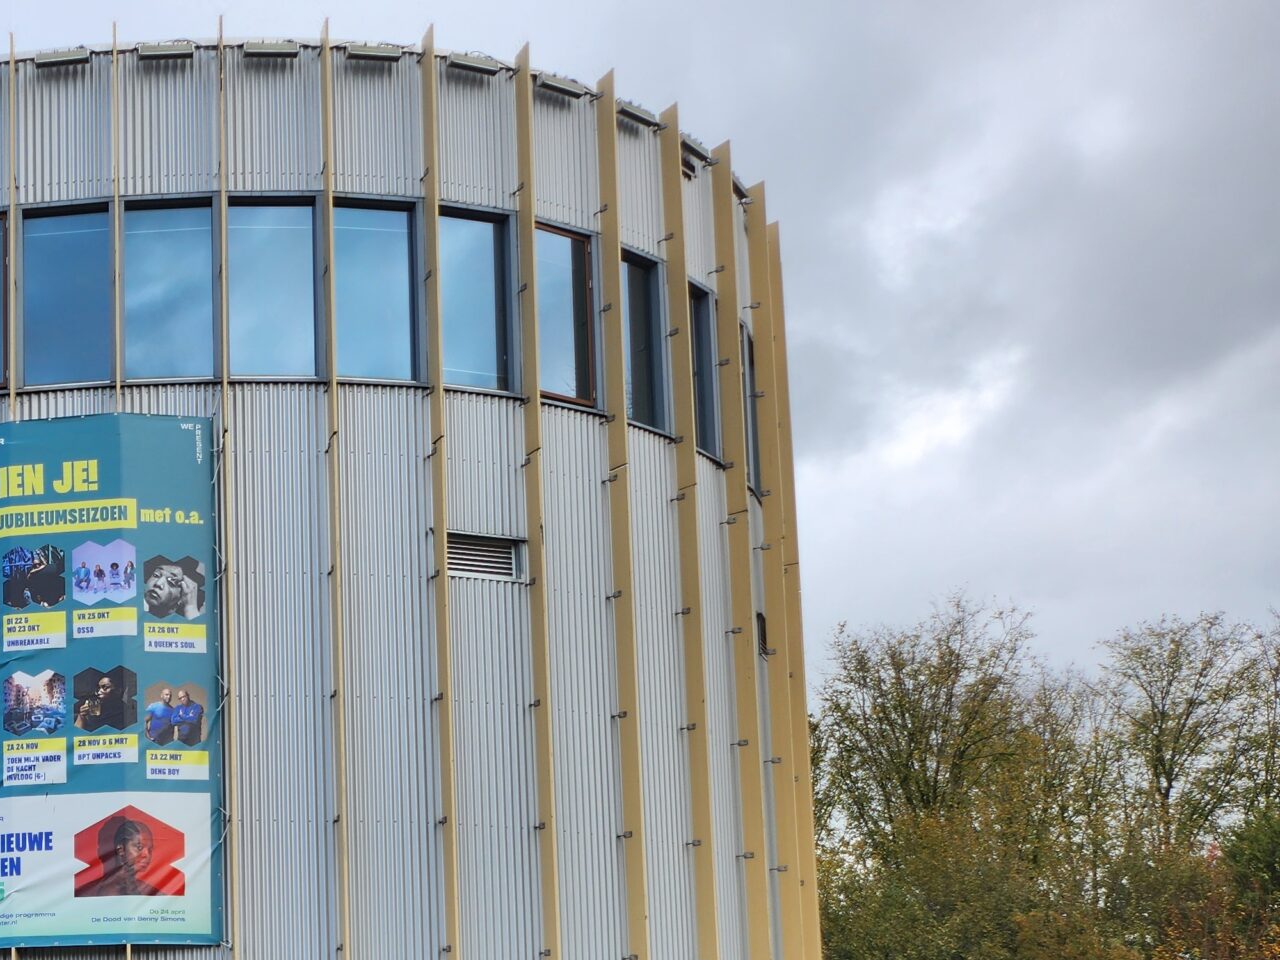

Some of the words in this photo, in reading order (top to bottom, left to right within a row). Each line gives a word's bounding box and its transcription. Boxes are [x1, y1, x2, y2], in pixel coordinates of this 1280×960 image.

[53, 459, 98, 493] JE!
[140, 508, 172, 523] met
[175, 511, 204, 524] o.a.
[97, 611, 110, 619] OKT
[7, 638, 50, 647] UNBREAKABLE
[92, 752, 121, 760] UNPACKS
